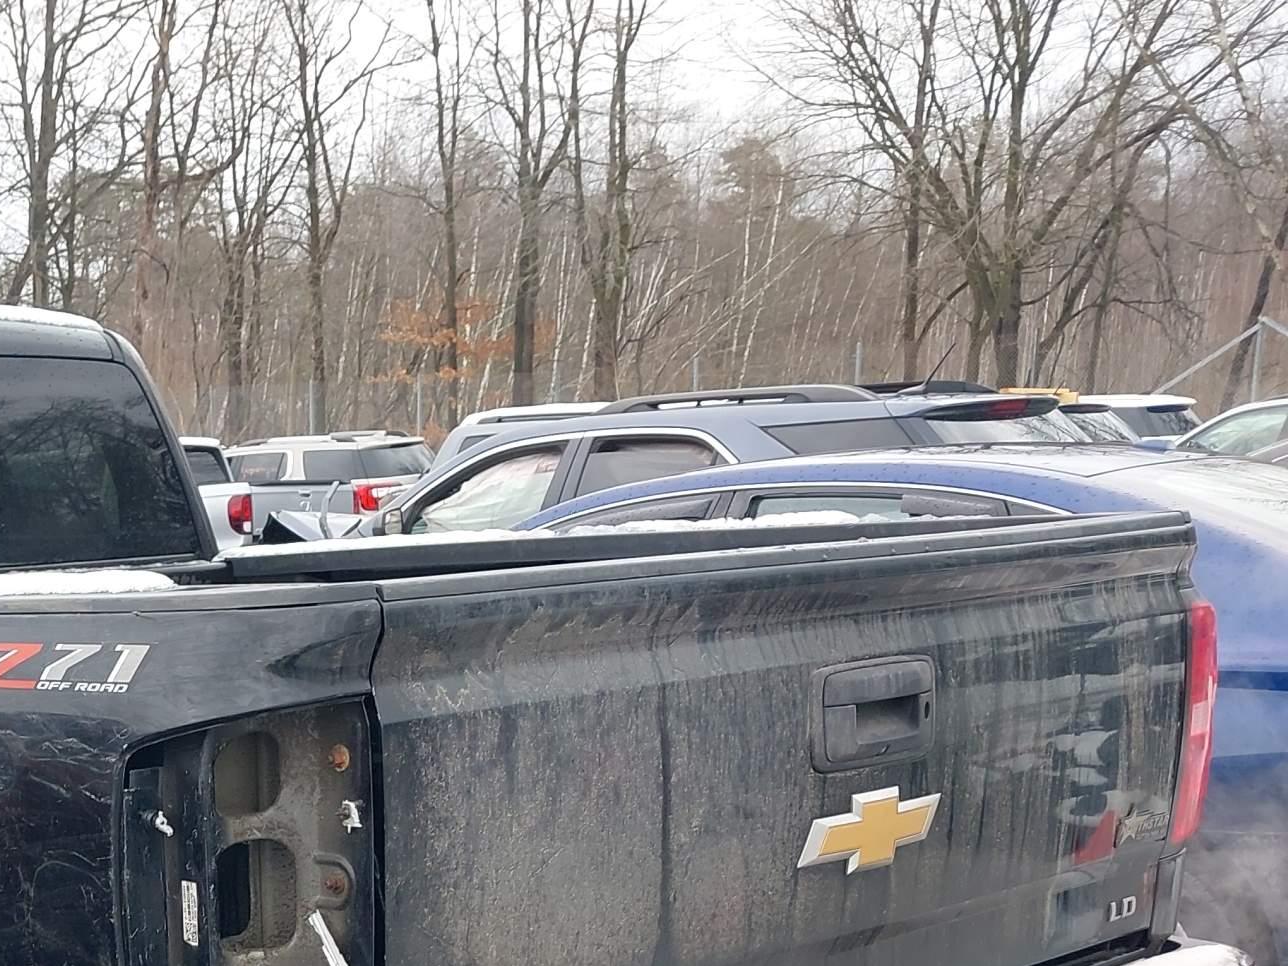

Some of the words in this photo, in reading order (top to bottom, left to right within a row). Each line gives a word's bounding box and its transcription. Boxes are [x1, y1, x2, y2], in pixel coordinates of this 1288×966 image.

[36, 680, 70, 691] OFF
[74, 681, 128, 693] ROAD
[1109, 895, 1137, 922] LD
